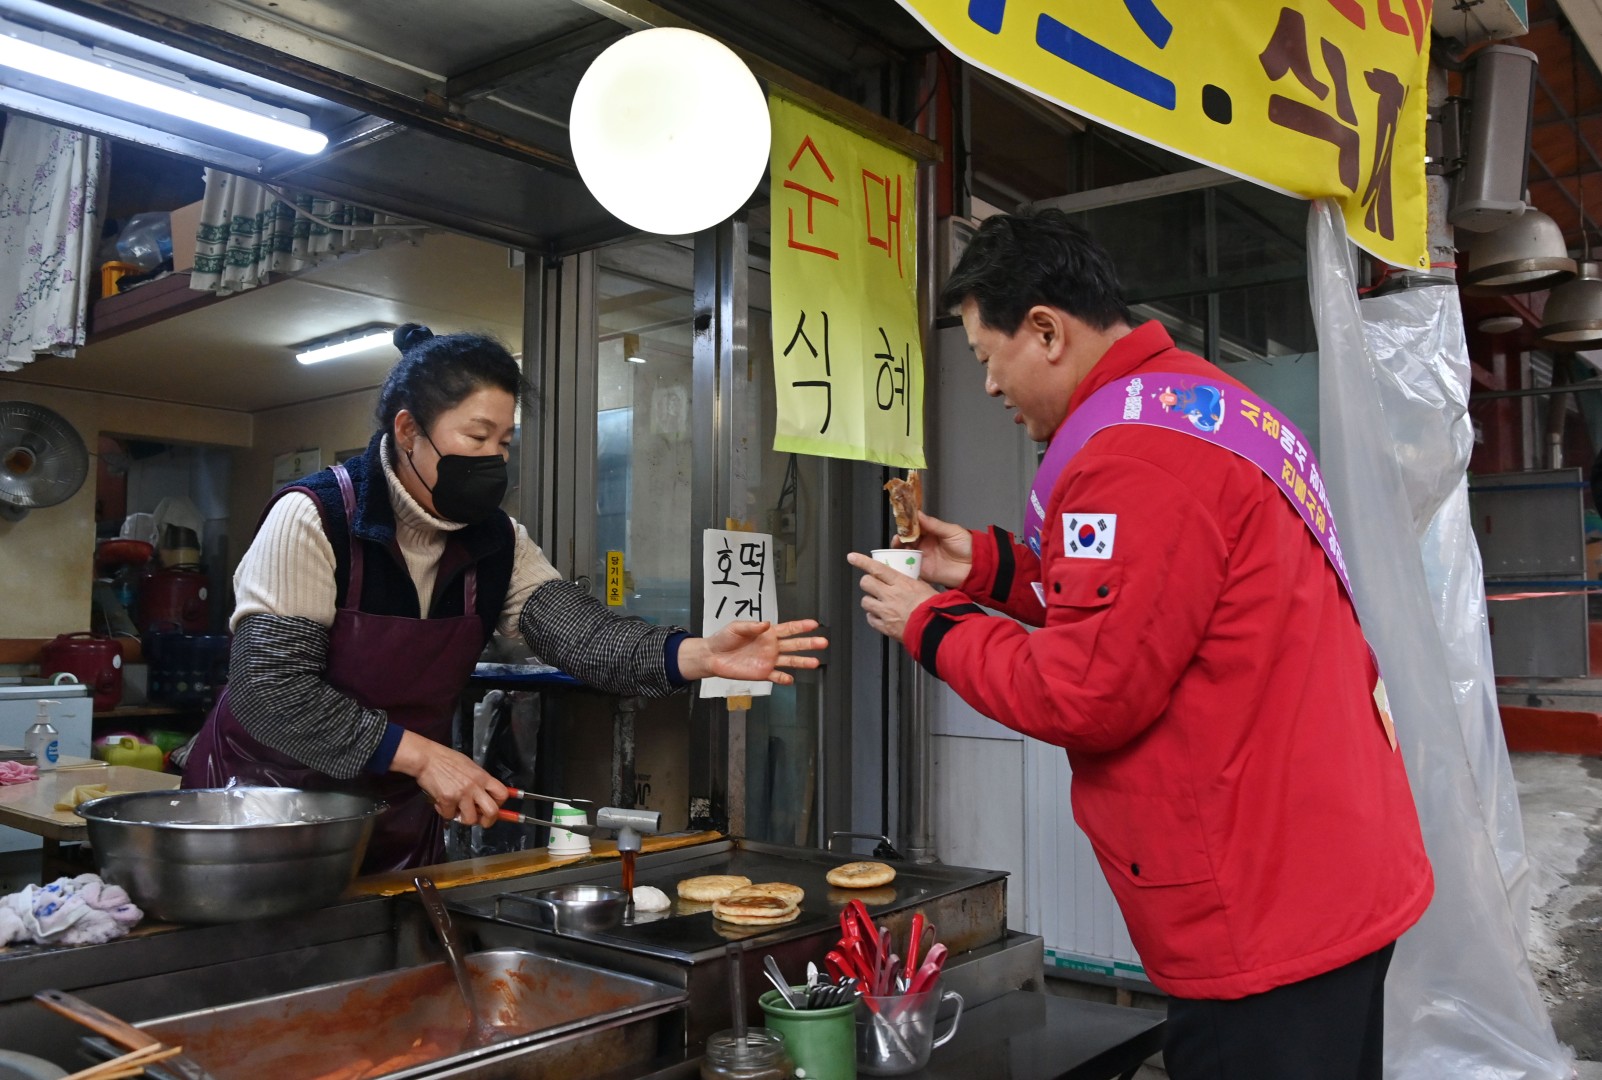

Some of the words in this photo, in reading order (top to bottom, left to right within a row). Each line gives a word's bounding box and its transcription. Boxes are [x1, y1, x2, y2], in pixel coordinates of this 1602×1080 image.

[783, 134, 903, 279] 순대
[783, 310, 910, 437] 식혜
[610, 556, 620, 596] 당기시오
[711, 536, 766, 593] 호떡
